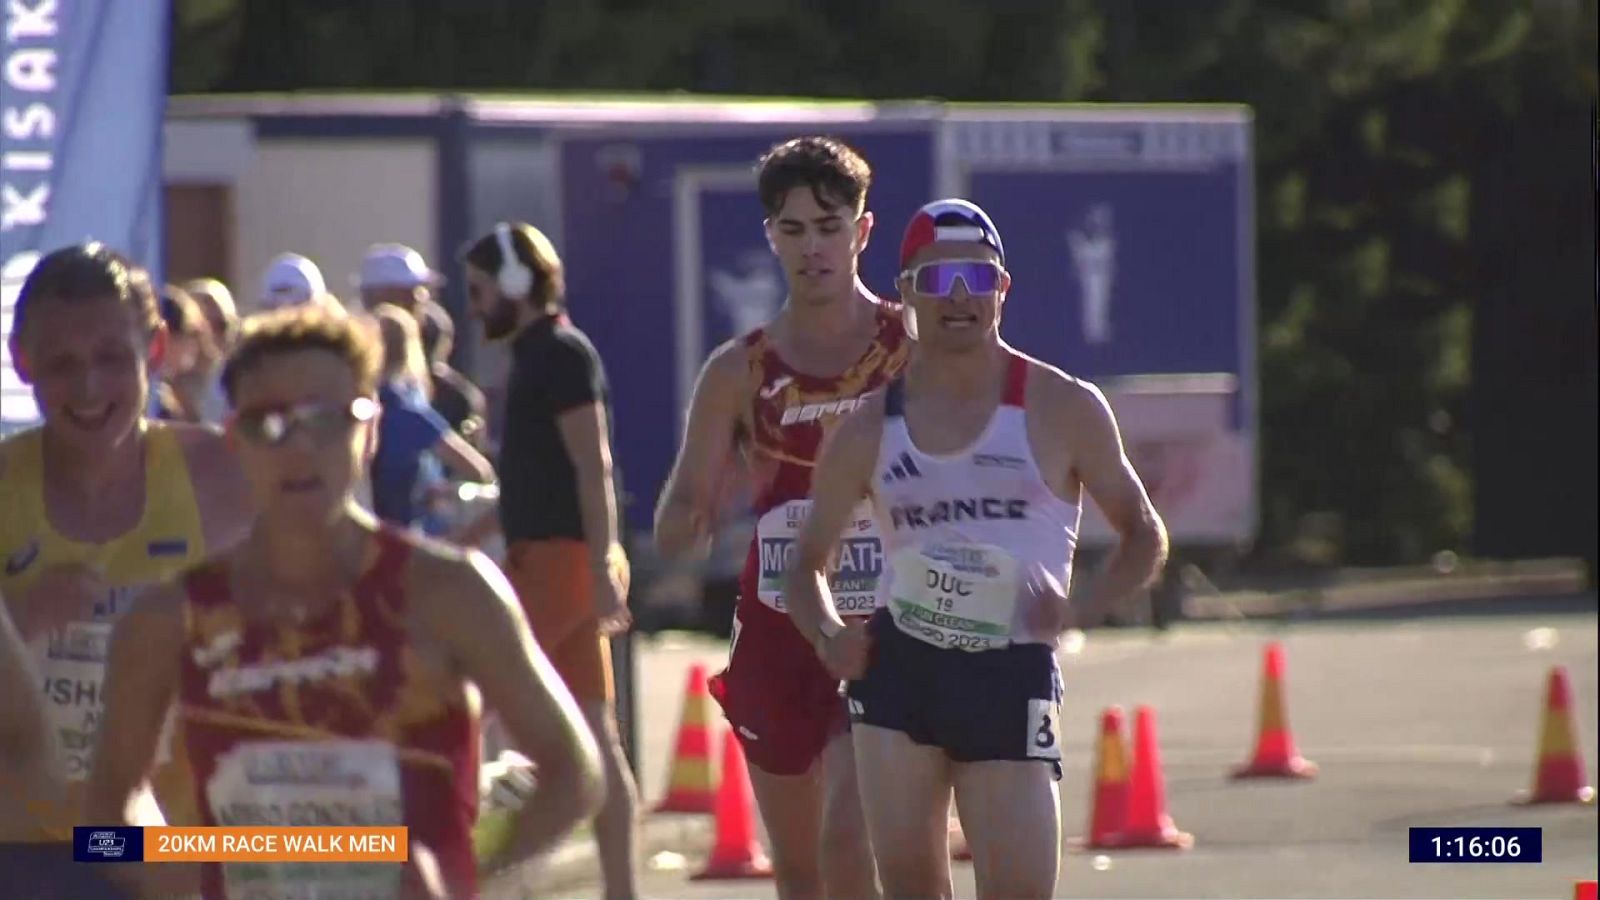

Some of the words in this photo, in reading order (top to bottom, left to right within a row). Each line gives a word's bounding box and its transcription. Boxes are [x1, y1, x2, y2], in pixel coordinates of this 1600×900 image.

[890, 498, 1028, 530] FRANCE
[926, 569, 974, 597] DUC
[836, 594, 876, 610] 2023
[948, 632, 991, 649] 2023
